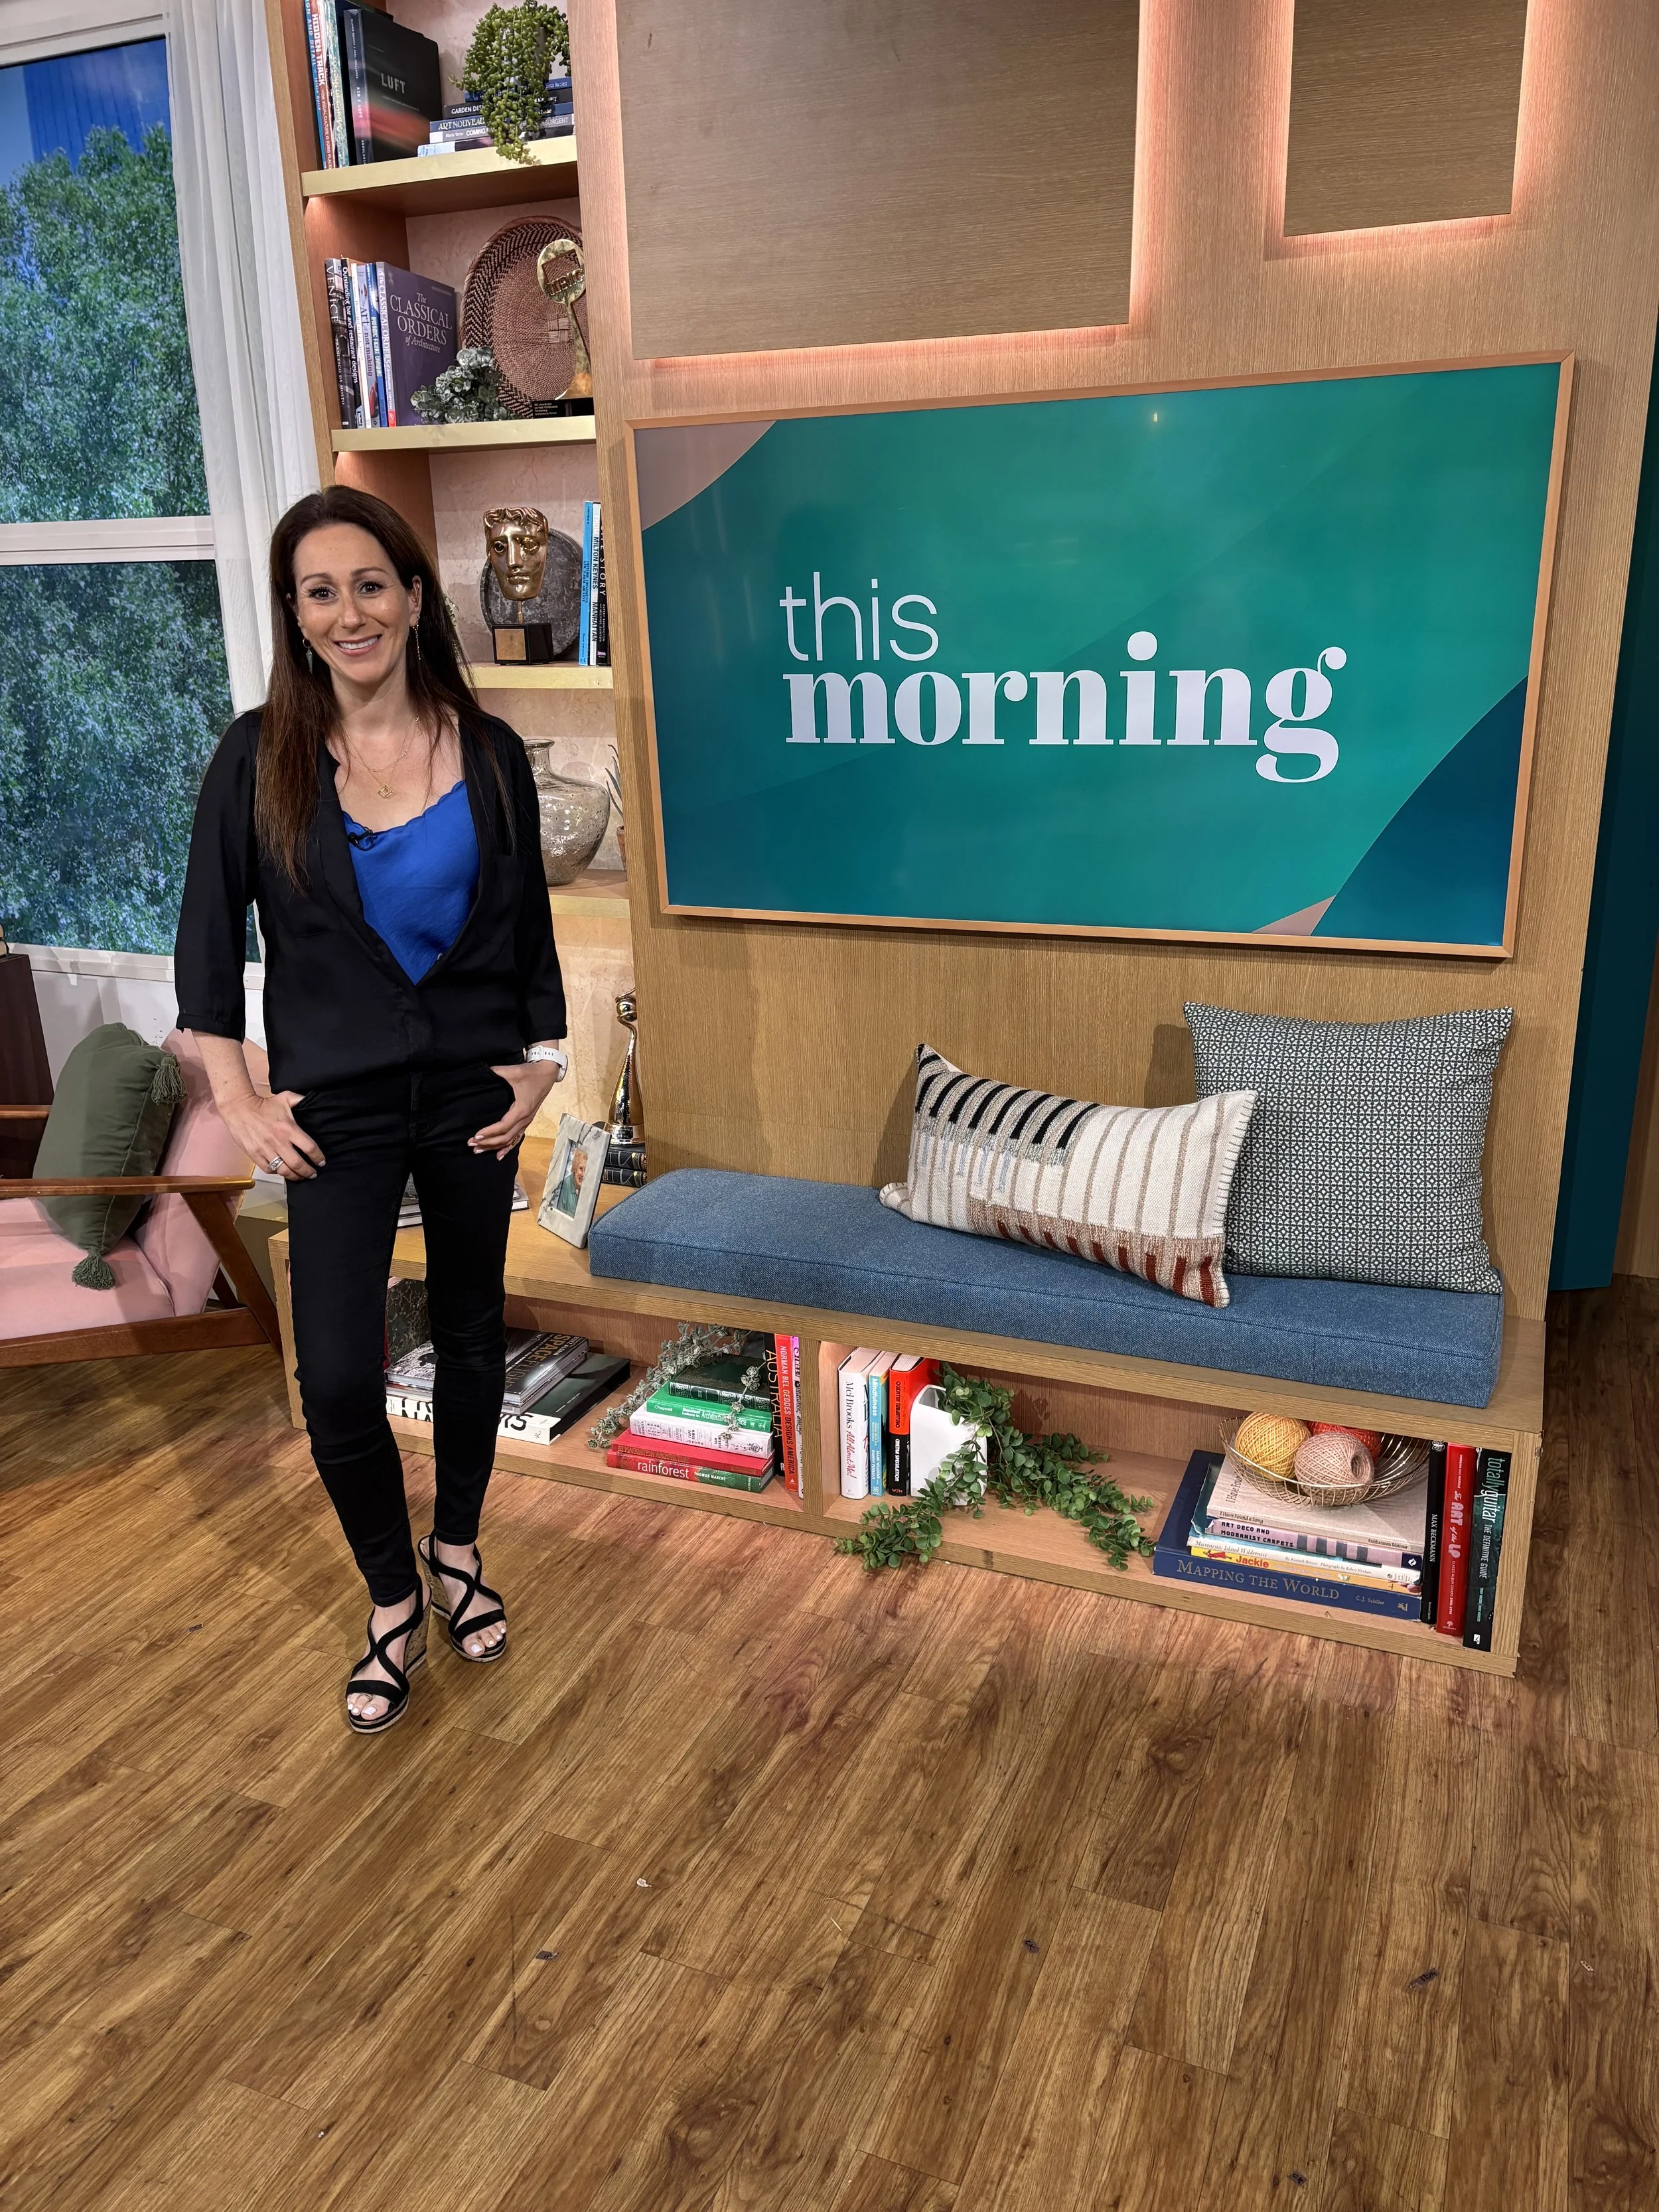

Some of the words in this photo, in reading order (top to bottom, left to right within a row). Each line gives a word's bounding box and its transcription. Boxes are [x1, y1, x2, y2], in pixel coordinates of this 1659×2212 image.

[311, 13, 323, 53] HIDDEN
[316, 54, 325, 86] TRACK
[380, 72, 405, 94] LUFT
[438, 121, 453, 131] ART
[453, 117, 486, 129] NOUVEAU
[466, 128, 486, 137] COMING
[326, 265, 340, 322] VENICE
[416, 292, 427, 303] The
[360, 307, 370, 326] Art
[378, 285, 389, 329] CLASSICAL
[390, 294, 453, 330] CLASSICAL
[397, 315, 447, 345] ORDERS
[382, 330, 392, 364] ORDERS
[405, 334, 411, 346] of
[411, 336, 441, 354] Architecture
[779, 571, 939, 662] this
[782, 630, 1347, 783] morning
[780, 1345, 789, 1374] NORMAN
[765, 1349, 782, 1438] AUSTRALIA
[845, 1381, 855, 1398] Mel
[783, 1390, 792, 1415] GEDDES
[845, 1399, 855, 1429] Brooks
[784, 1416, 793, 1445] DESIGNS
[846, 1430, 855, 1444] All
[638, 1460, 689, 1479] rainforest
[786, 1446, 795, 1474] AMERICA
[847, 1464, 857, 1479] Me!
[1226, 1487, 1240, 1502] Have
[1450, 1501, 1464, 1526] ART
[1220, 1530, 1261, 1542] MODERNIST
[1263, 1538, 1294, 1548] CARPETS
[1236, 1524, 1254, 1532] DECO
[1449, 1526, 1458, 1536] of
[1484, 1524, 1492, 1534] THE
[1195, 1540, 1223, 1550] Micronesia:
[1224, 1545, 1240, 1554] Island
[1240, 1548, 1267, 1558] Wilderness
[1448, 1544, 1461, 1558] LP
[1480, 1535, 1492, 1562] DEFINITIVE
[1236, 1556, 1269, 1569] Jackie
[1479, 1563, 1488, 1579] GUIDE
[1177, 1560, 1246, 1584] MAPPING
[1248, 1575, 1278, 1589] THE
[1282, 1578, 1340, 1599] WORLD
